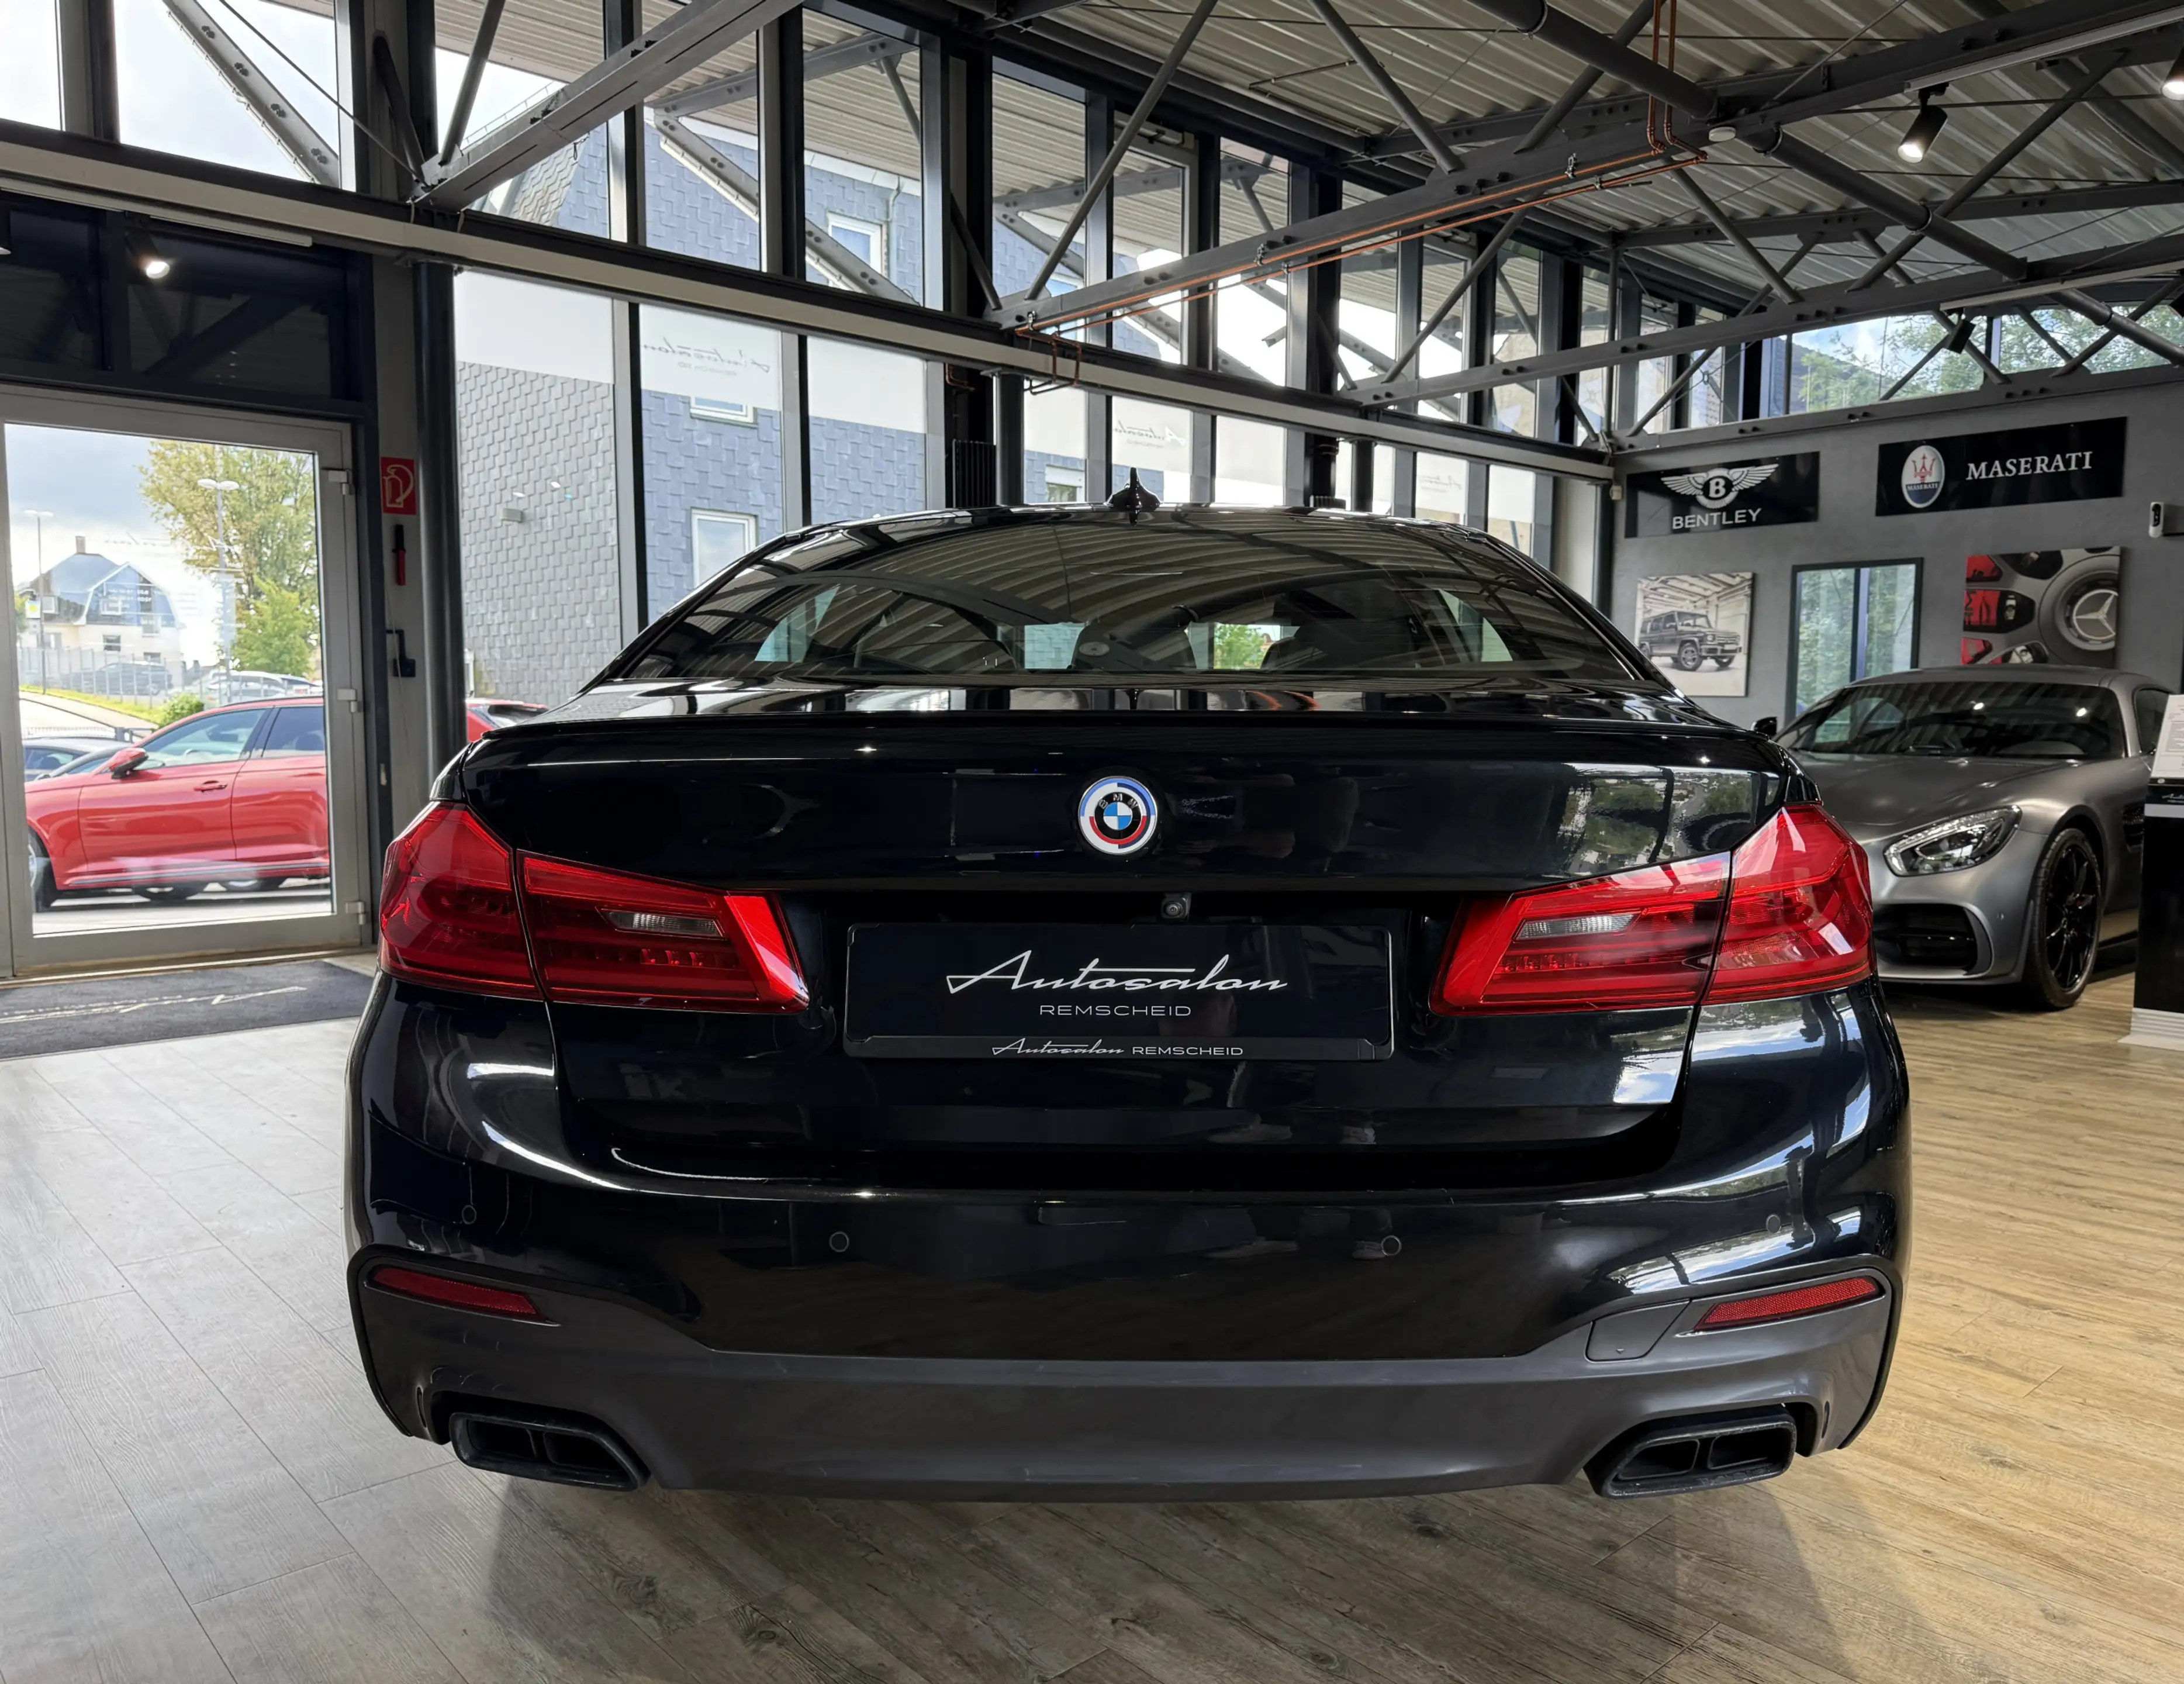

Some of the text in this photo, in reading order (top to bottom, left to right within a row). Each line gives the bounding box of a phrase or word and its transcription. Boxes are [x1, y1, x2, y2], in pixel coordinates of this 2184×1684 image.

[1967, 451, 2092, 480] MASERATI
[1907, 482, 1939, 491] MASERATI
[1672, 507, 1762, 530] BENTLEY
[1098, 792, 1139, 810] BMW
[946, 950, 1288, 994] Autosalon
[1039, 1004, 1191, 1016] REMSCHEID
[990, 1037, 1243, 1056] Autosalon REMSCHEID
